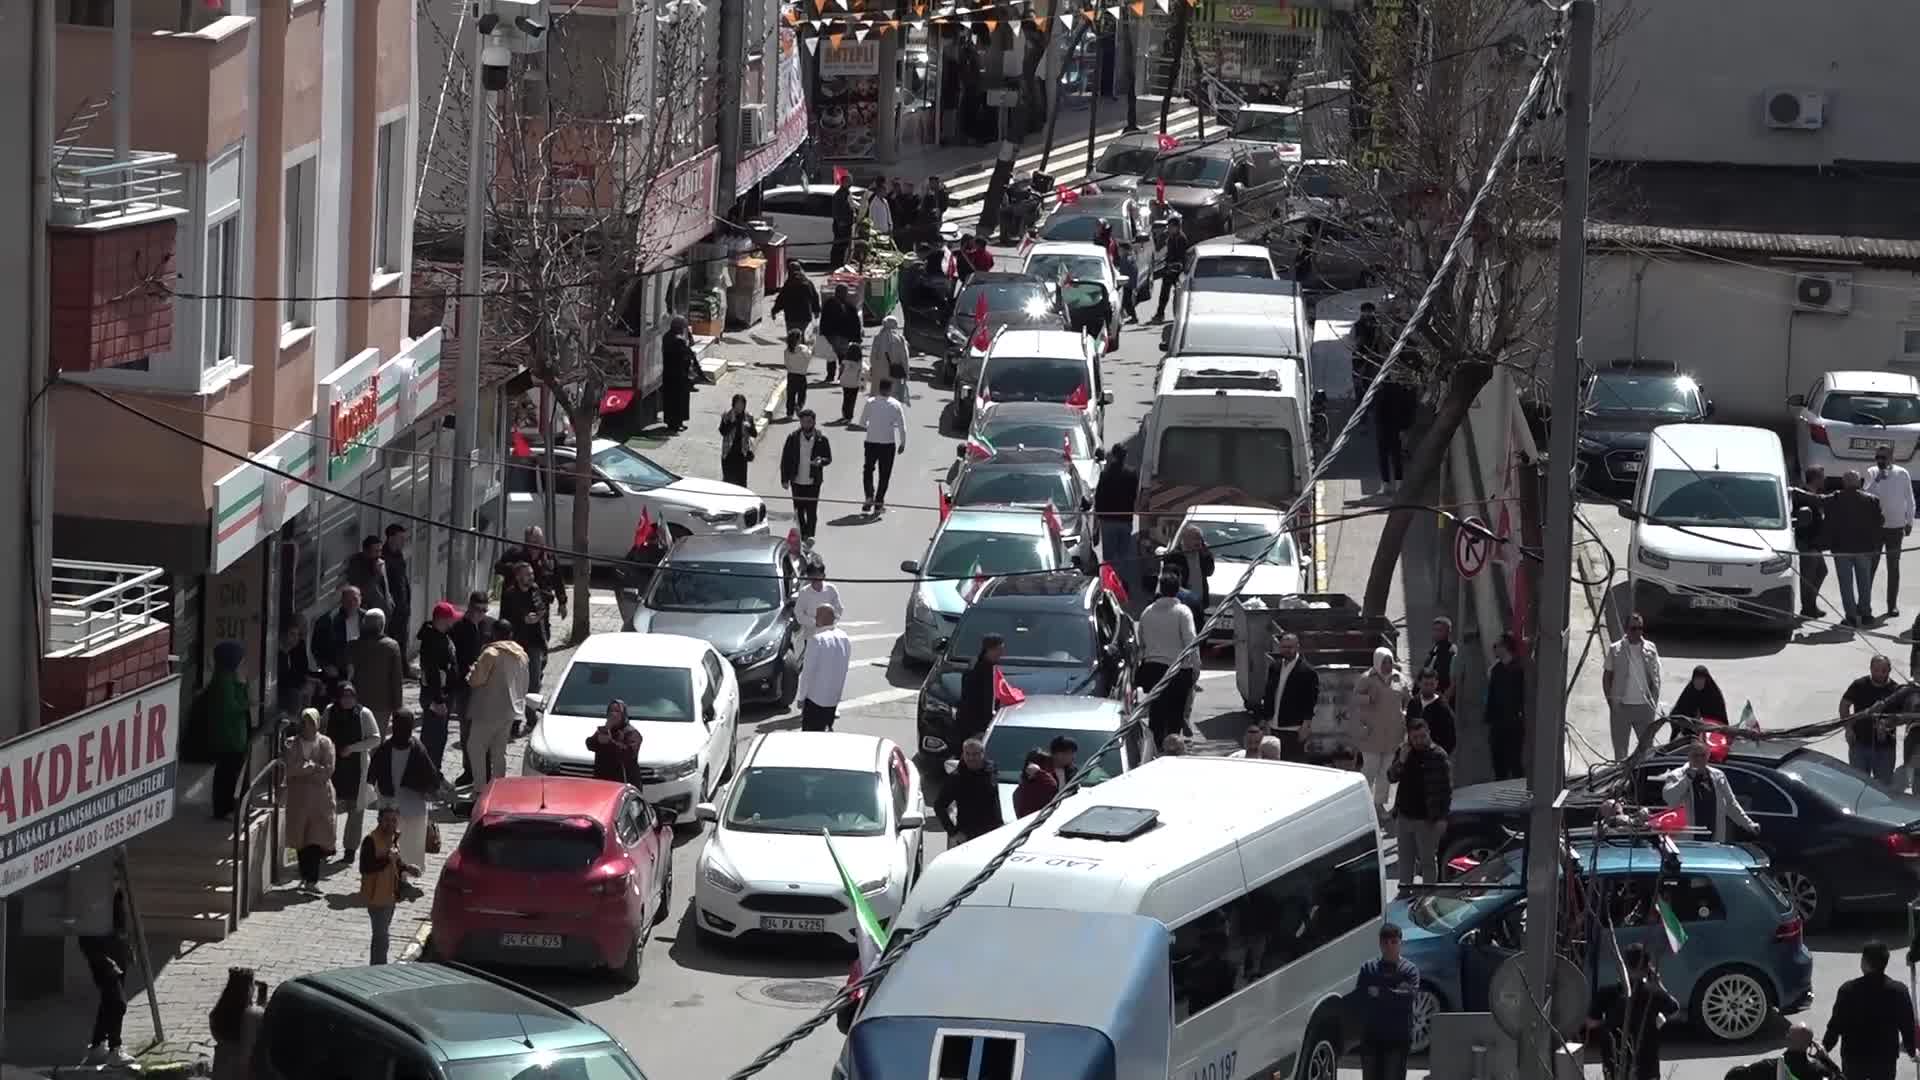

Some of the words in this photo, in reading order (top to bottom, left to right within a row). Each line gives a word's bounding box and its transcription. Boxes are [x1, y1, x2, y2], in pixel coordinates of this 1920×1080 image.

[0, 700, 166, 824] AKDEMİR
[118, 768, 165, 806] HİZMETLERİ
[33, 848, 54, 874] 0507
[104, 816, 125, 840] 0535
